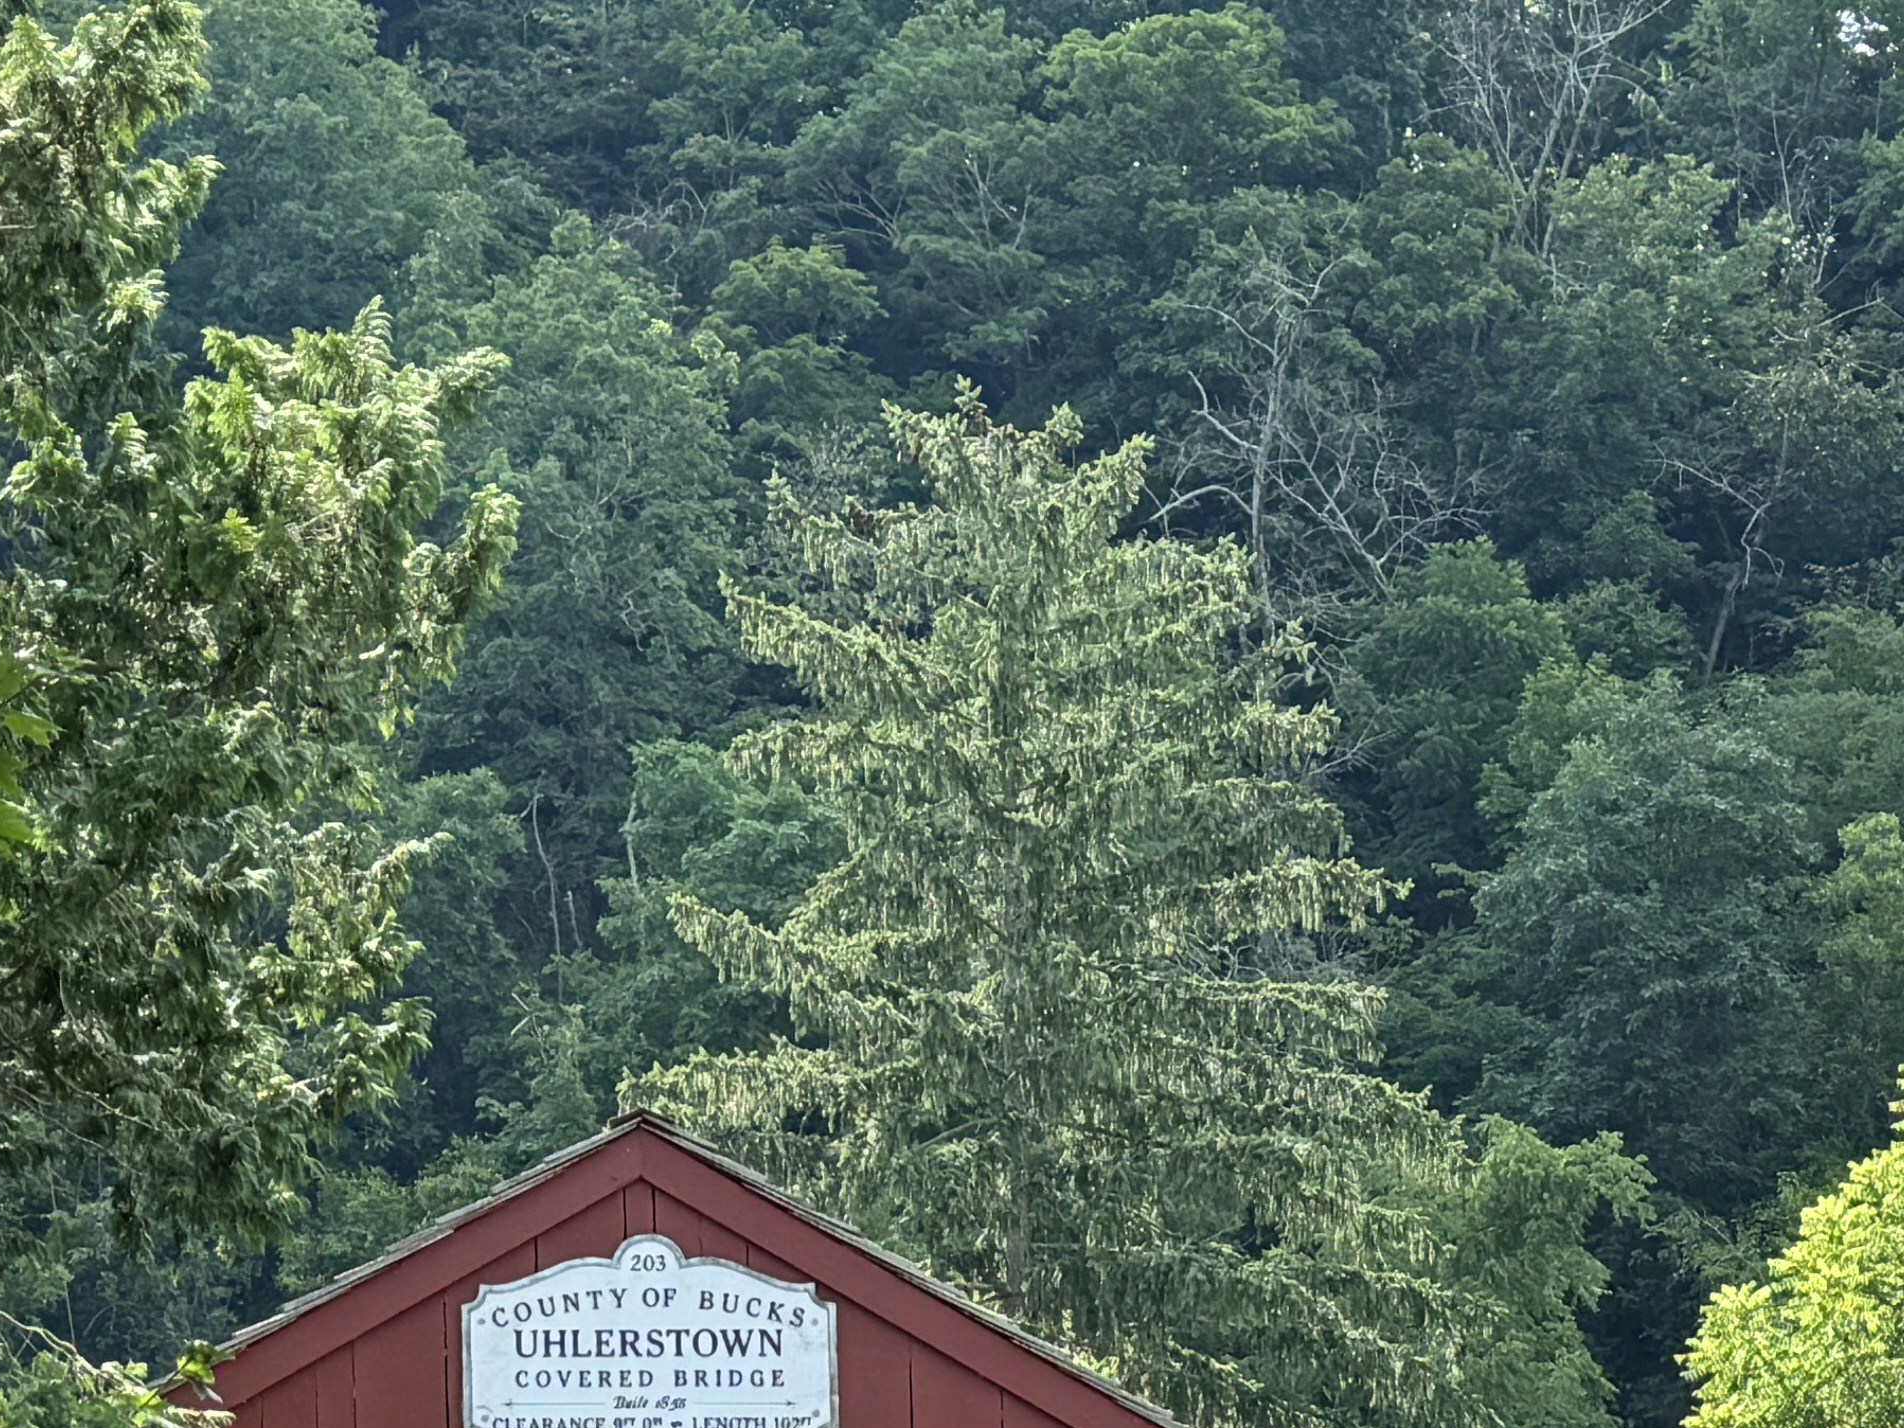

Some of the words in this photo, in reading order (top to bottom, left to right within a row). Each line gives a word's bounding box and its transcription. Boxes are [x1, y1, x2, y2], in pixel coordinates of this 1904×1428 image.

[630, 1254, 666, 1272] 203
[492, 1287, 628, 1328] COUNTY
[641, 1287, 678, 1307] OF
[699, 1291, 805, 1328] BUCKS
[513, 1328, 783, 1358] UHLERSTOWN
[515, 1370, 654, 1388] COVERED
[674, 1369, 785, 1388] BRIDGE
